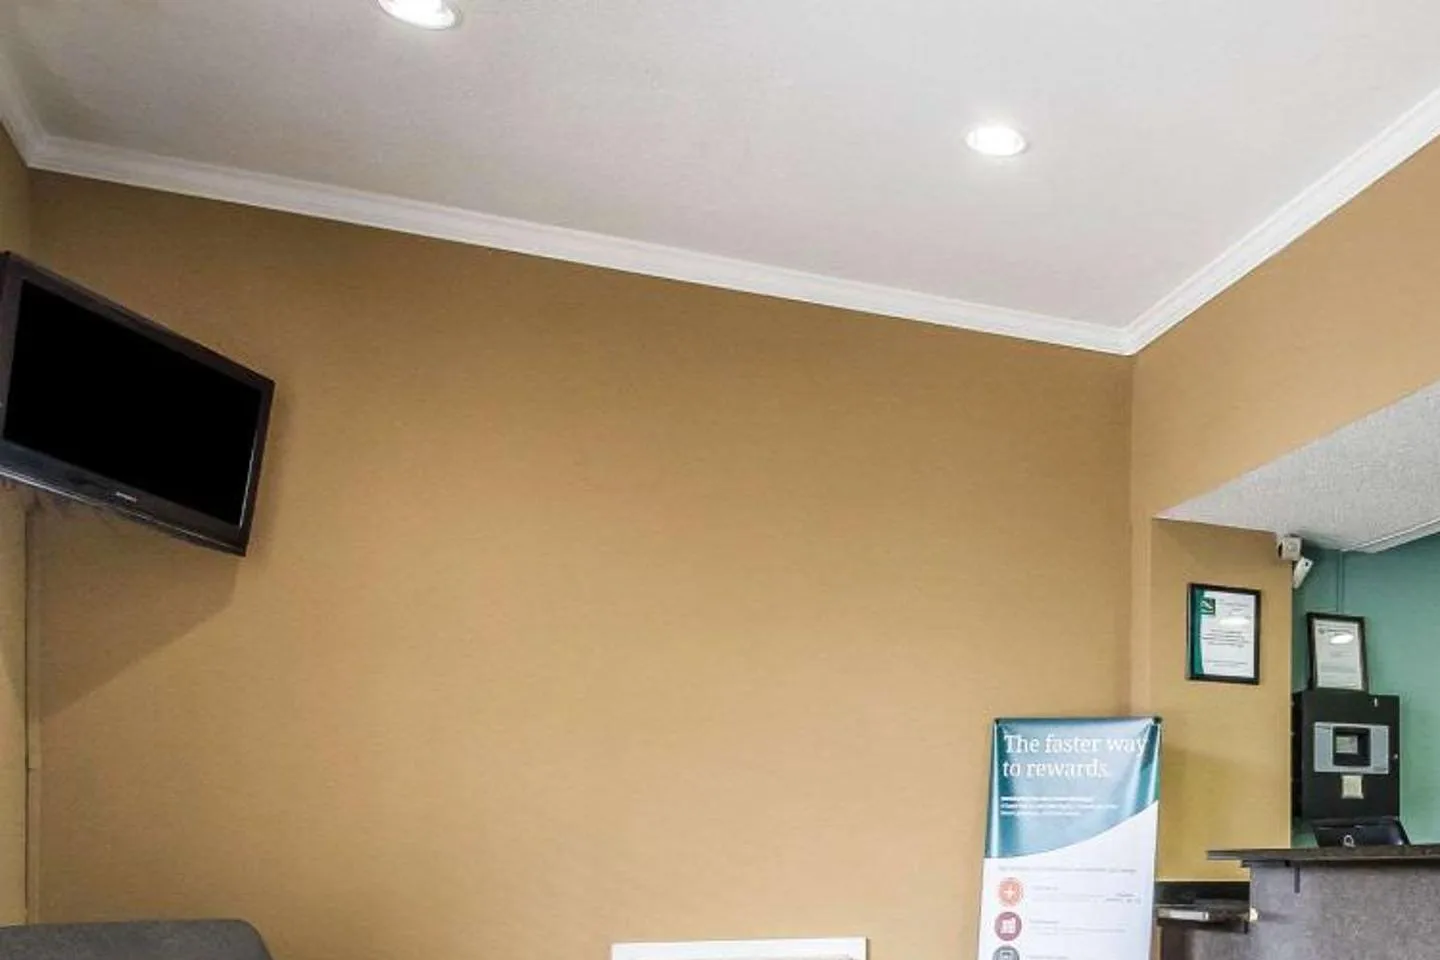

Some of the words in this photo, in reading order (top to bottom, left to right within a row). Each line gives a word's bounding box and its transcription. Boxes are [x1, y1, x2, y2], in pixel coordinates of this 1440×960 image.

[1004, 734, 1040, 753] The
[1044, 733, 1101, 754] faster
[1106, 738, 1148, 757] way
[1003, 762, 1021, 777] to
